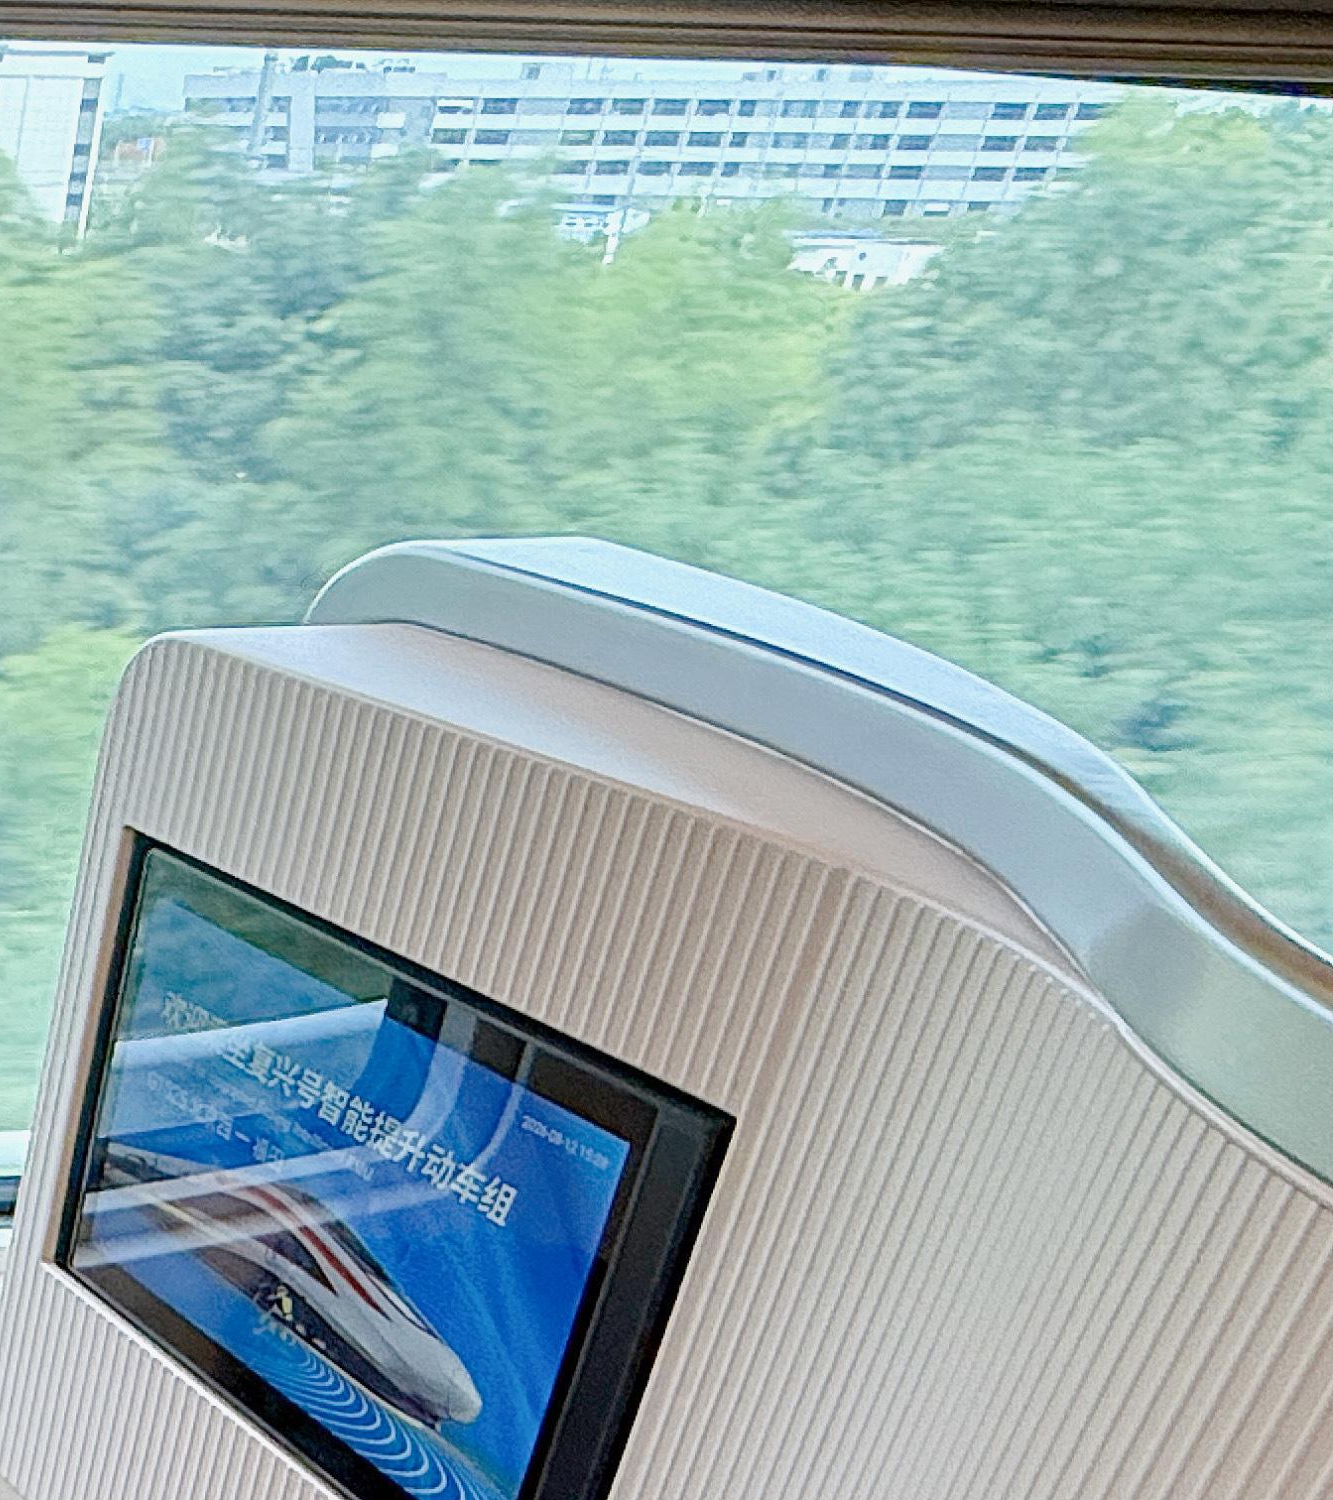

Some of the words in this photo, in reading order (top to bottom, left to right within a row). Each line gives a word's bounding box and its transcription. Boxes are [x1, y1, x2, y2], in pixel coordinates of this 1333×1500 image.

[161, 991, 518, 1227] 欢迎坐复兴号智能提升动车组
